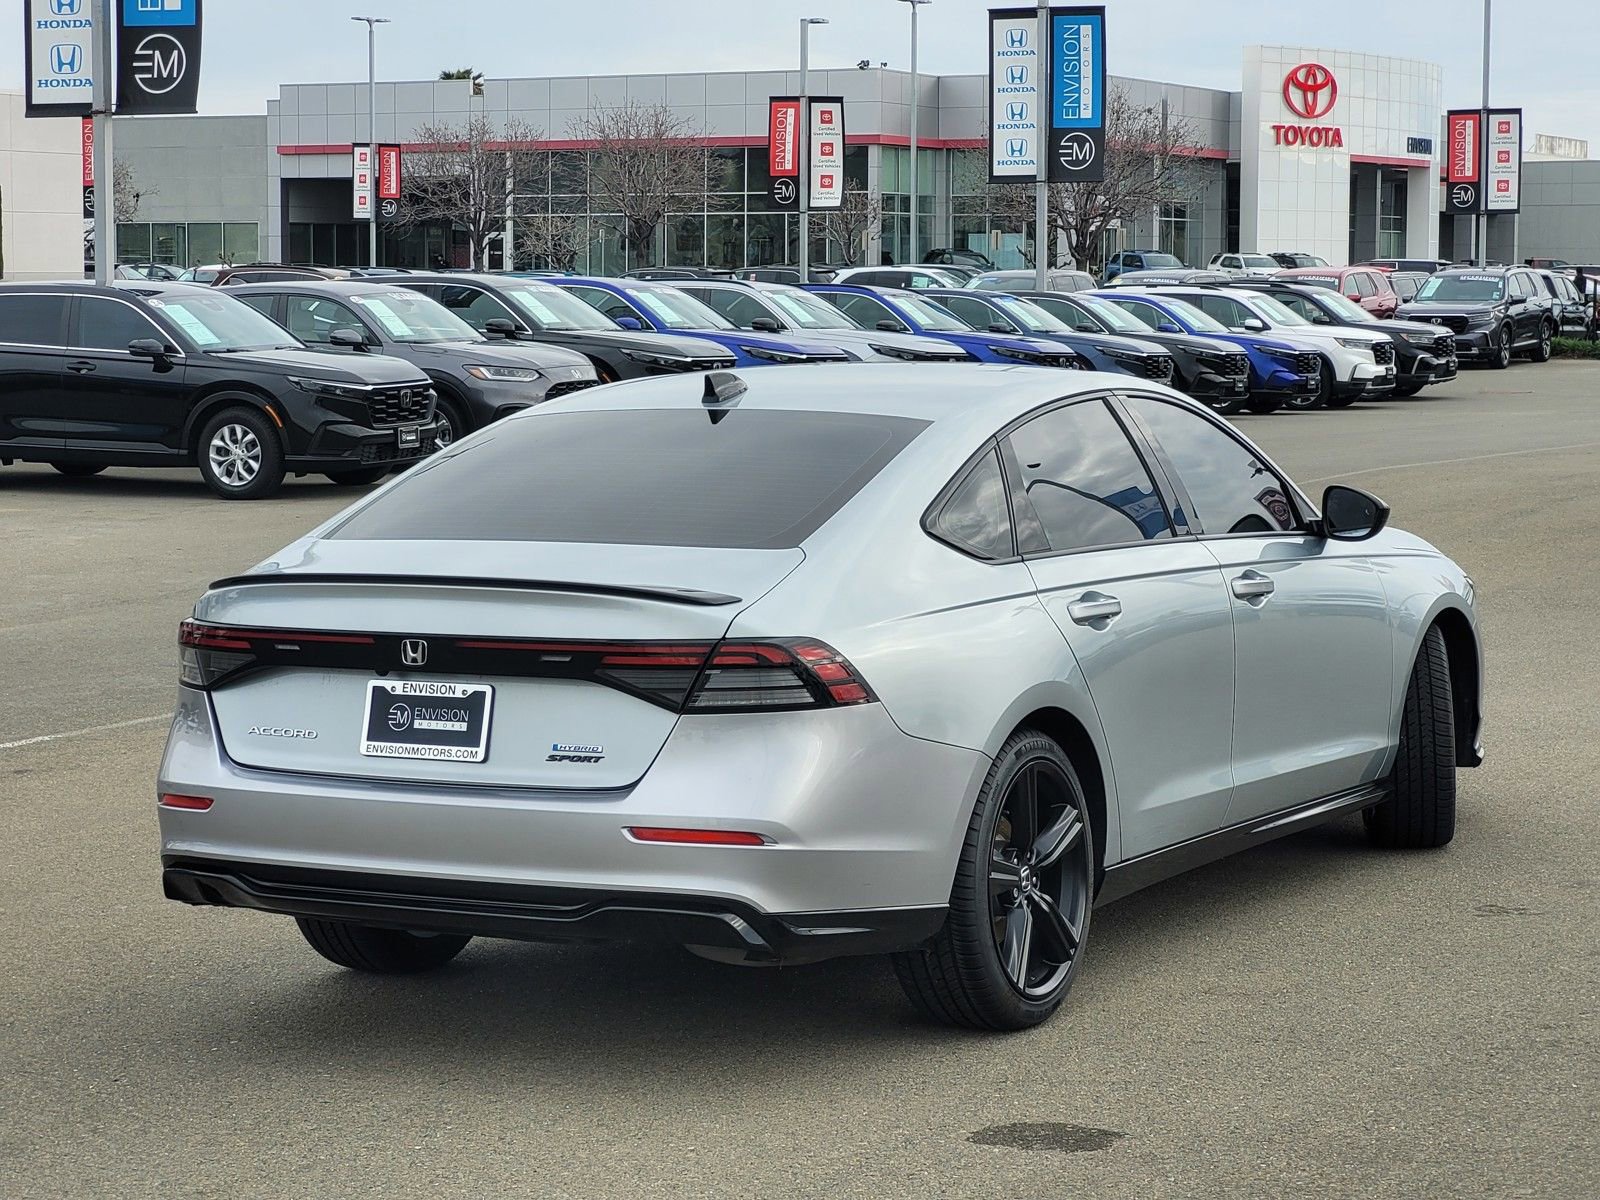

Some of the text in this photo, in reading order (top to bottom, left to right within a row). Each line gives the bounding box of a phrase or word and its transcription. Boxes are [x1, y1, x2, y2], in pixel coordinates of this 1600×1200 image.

[36, 19, 93, 29] HONDA
[1063, 24, 1080, 119] ENVISION
[37, 78, 93, 88] HONDA
[775, 107, 787, 171] ENVISION
[1272, 125, 1344, 148] TOYOTA
[84, 124, 94, 181] ENVISION
[1454, 120, 1466, 177] ENVISION
[383, 151, 391, 194] ENVISION
[402, 683, 456, 695] ENVISION
[414, 707, 469, 721] ENVISION
[247, 726, 318, 740] ACCORD
[366, 744, 478, 759] ENVISIONMOTORS.COM
[545, 755, 605, 763] SPORT
